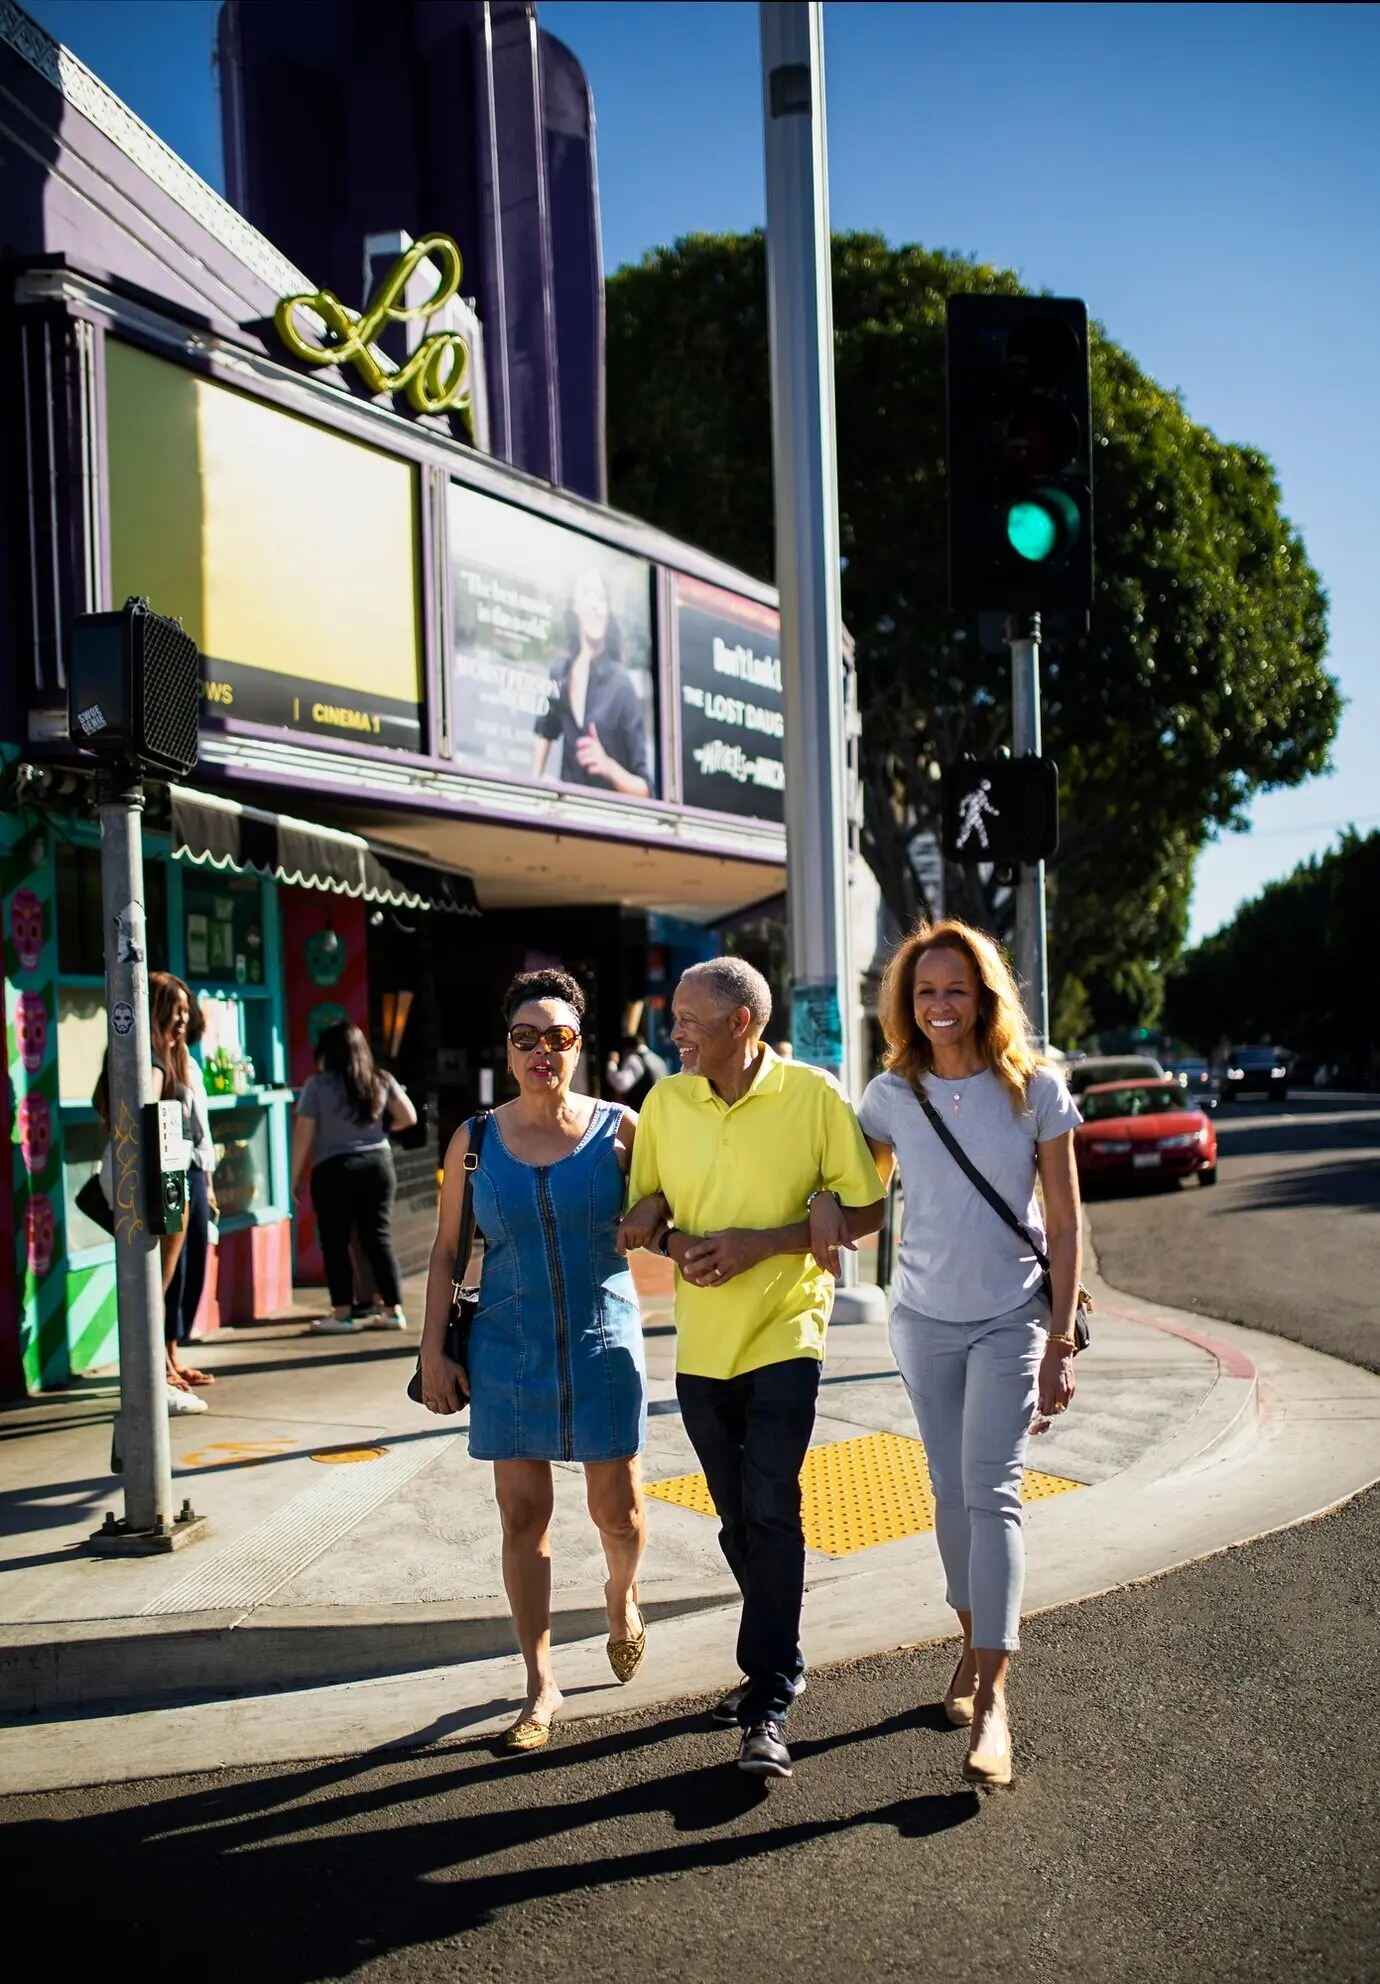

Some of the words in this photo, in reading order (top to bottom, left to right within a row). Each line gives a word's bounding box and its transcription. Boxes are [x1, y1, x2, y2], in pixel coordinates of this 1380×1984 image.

[274, 231, 472, 414] La
[312, 703, 372, 732] CINEMA
[371, 717, 381, 733] 1
[704, 692, 745, 726] LOST
